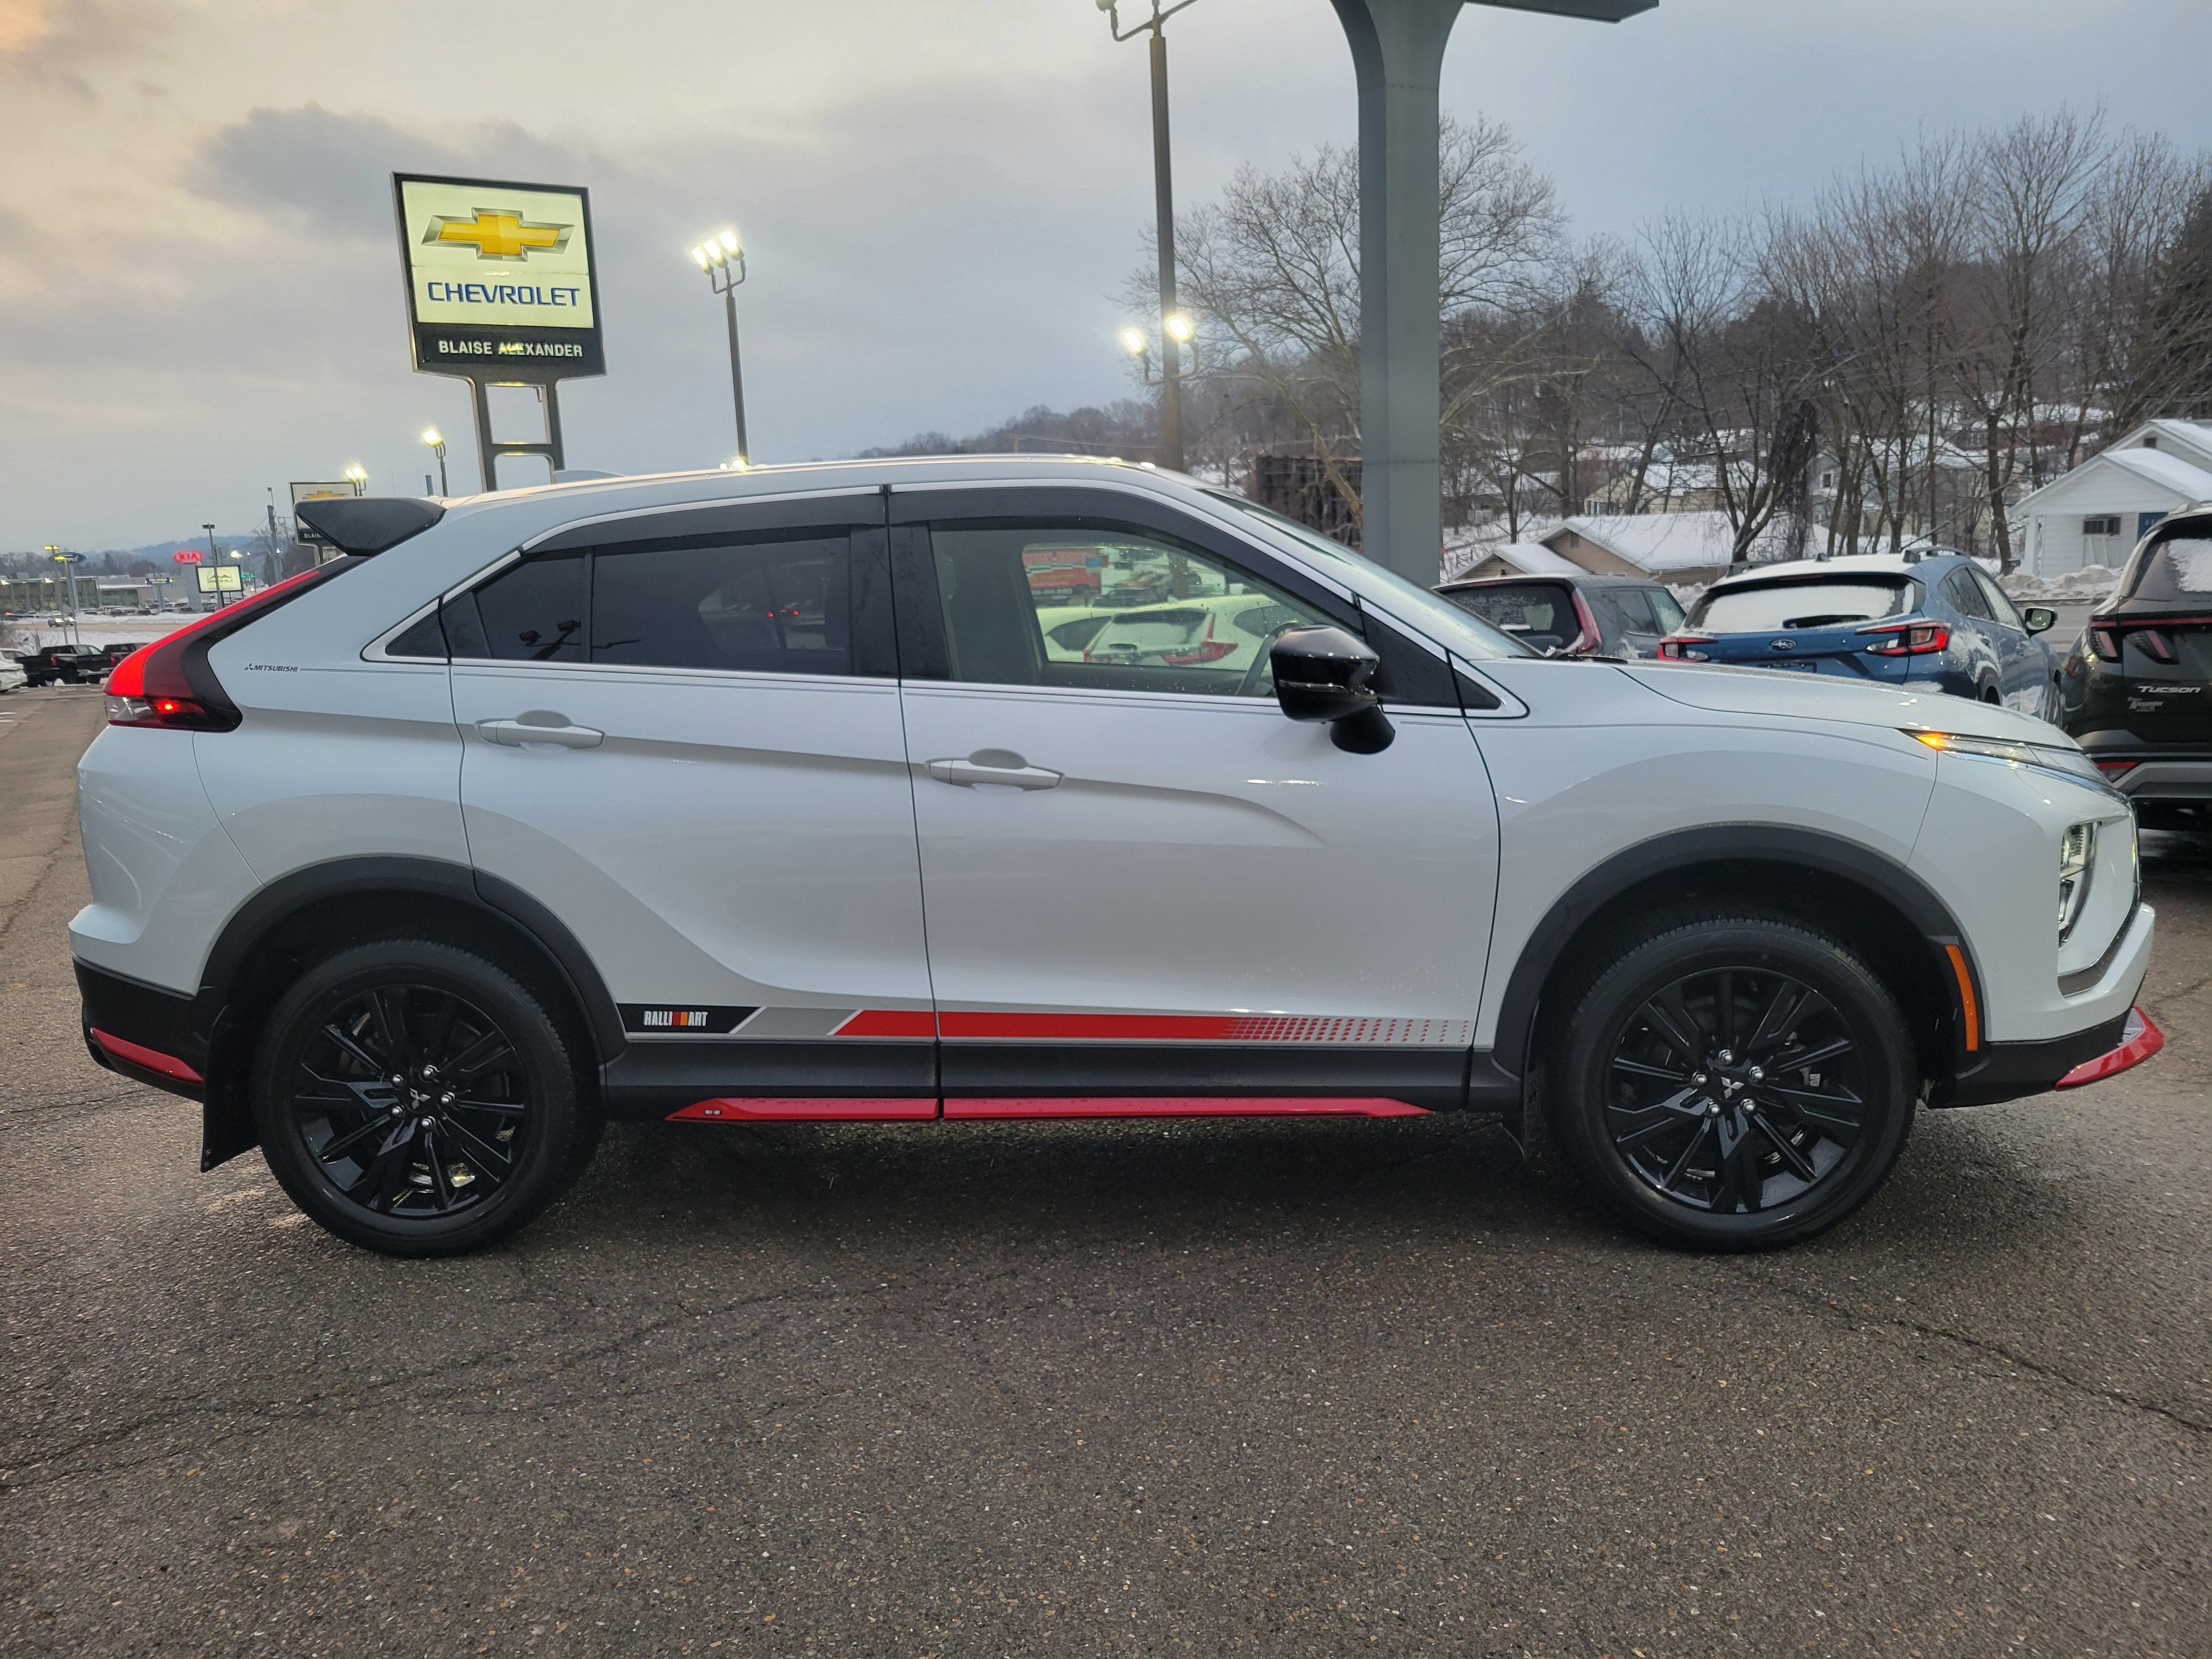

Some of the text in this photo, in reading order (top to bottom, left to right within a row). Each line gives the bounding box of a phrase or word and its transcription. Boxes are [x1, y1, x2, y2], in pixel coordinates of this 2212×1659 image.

[428, 282, 580, 306] CHEVROLET
[439, 340, 583, 357] BLAISE ALEXANDER
